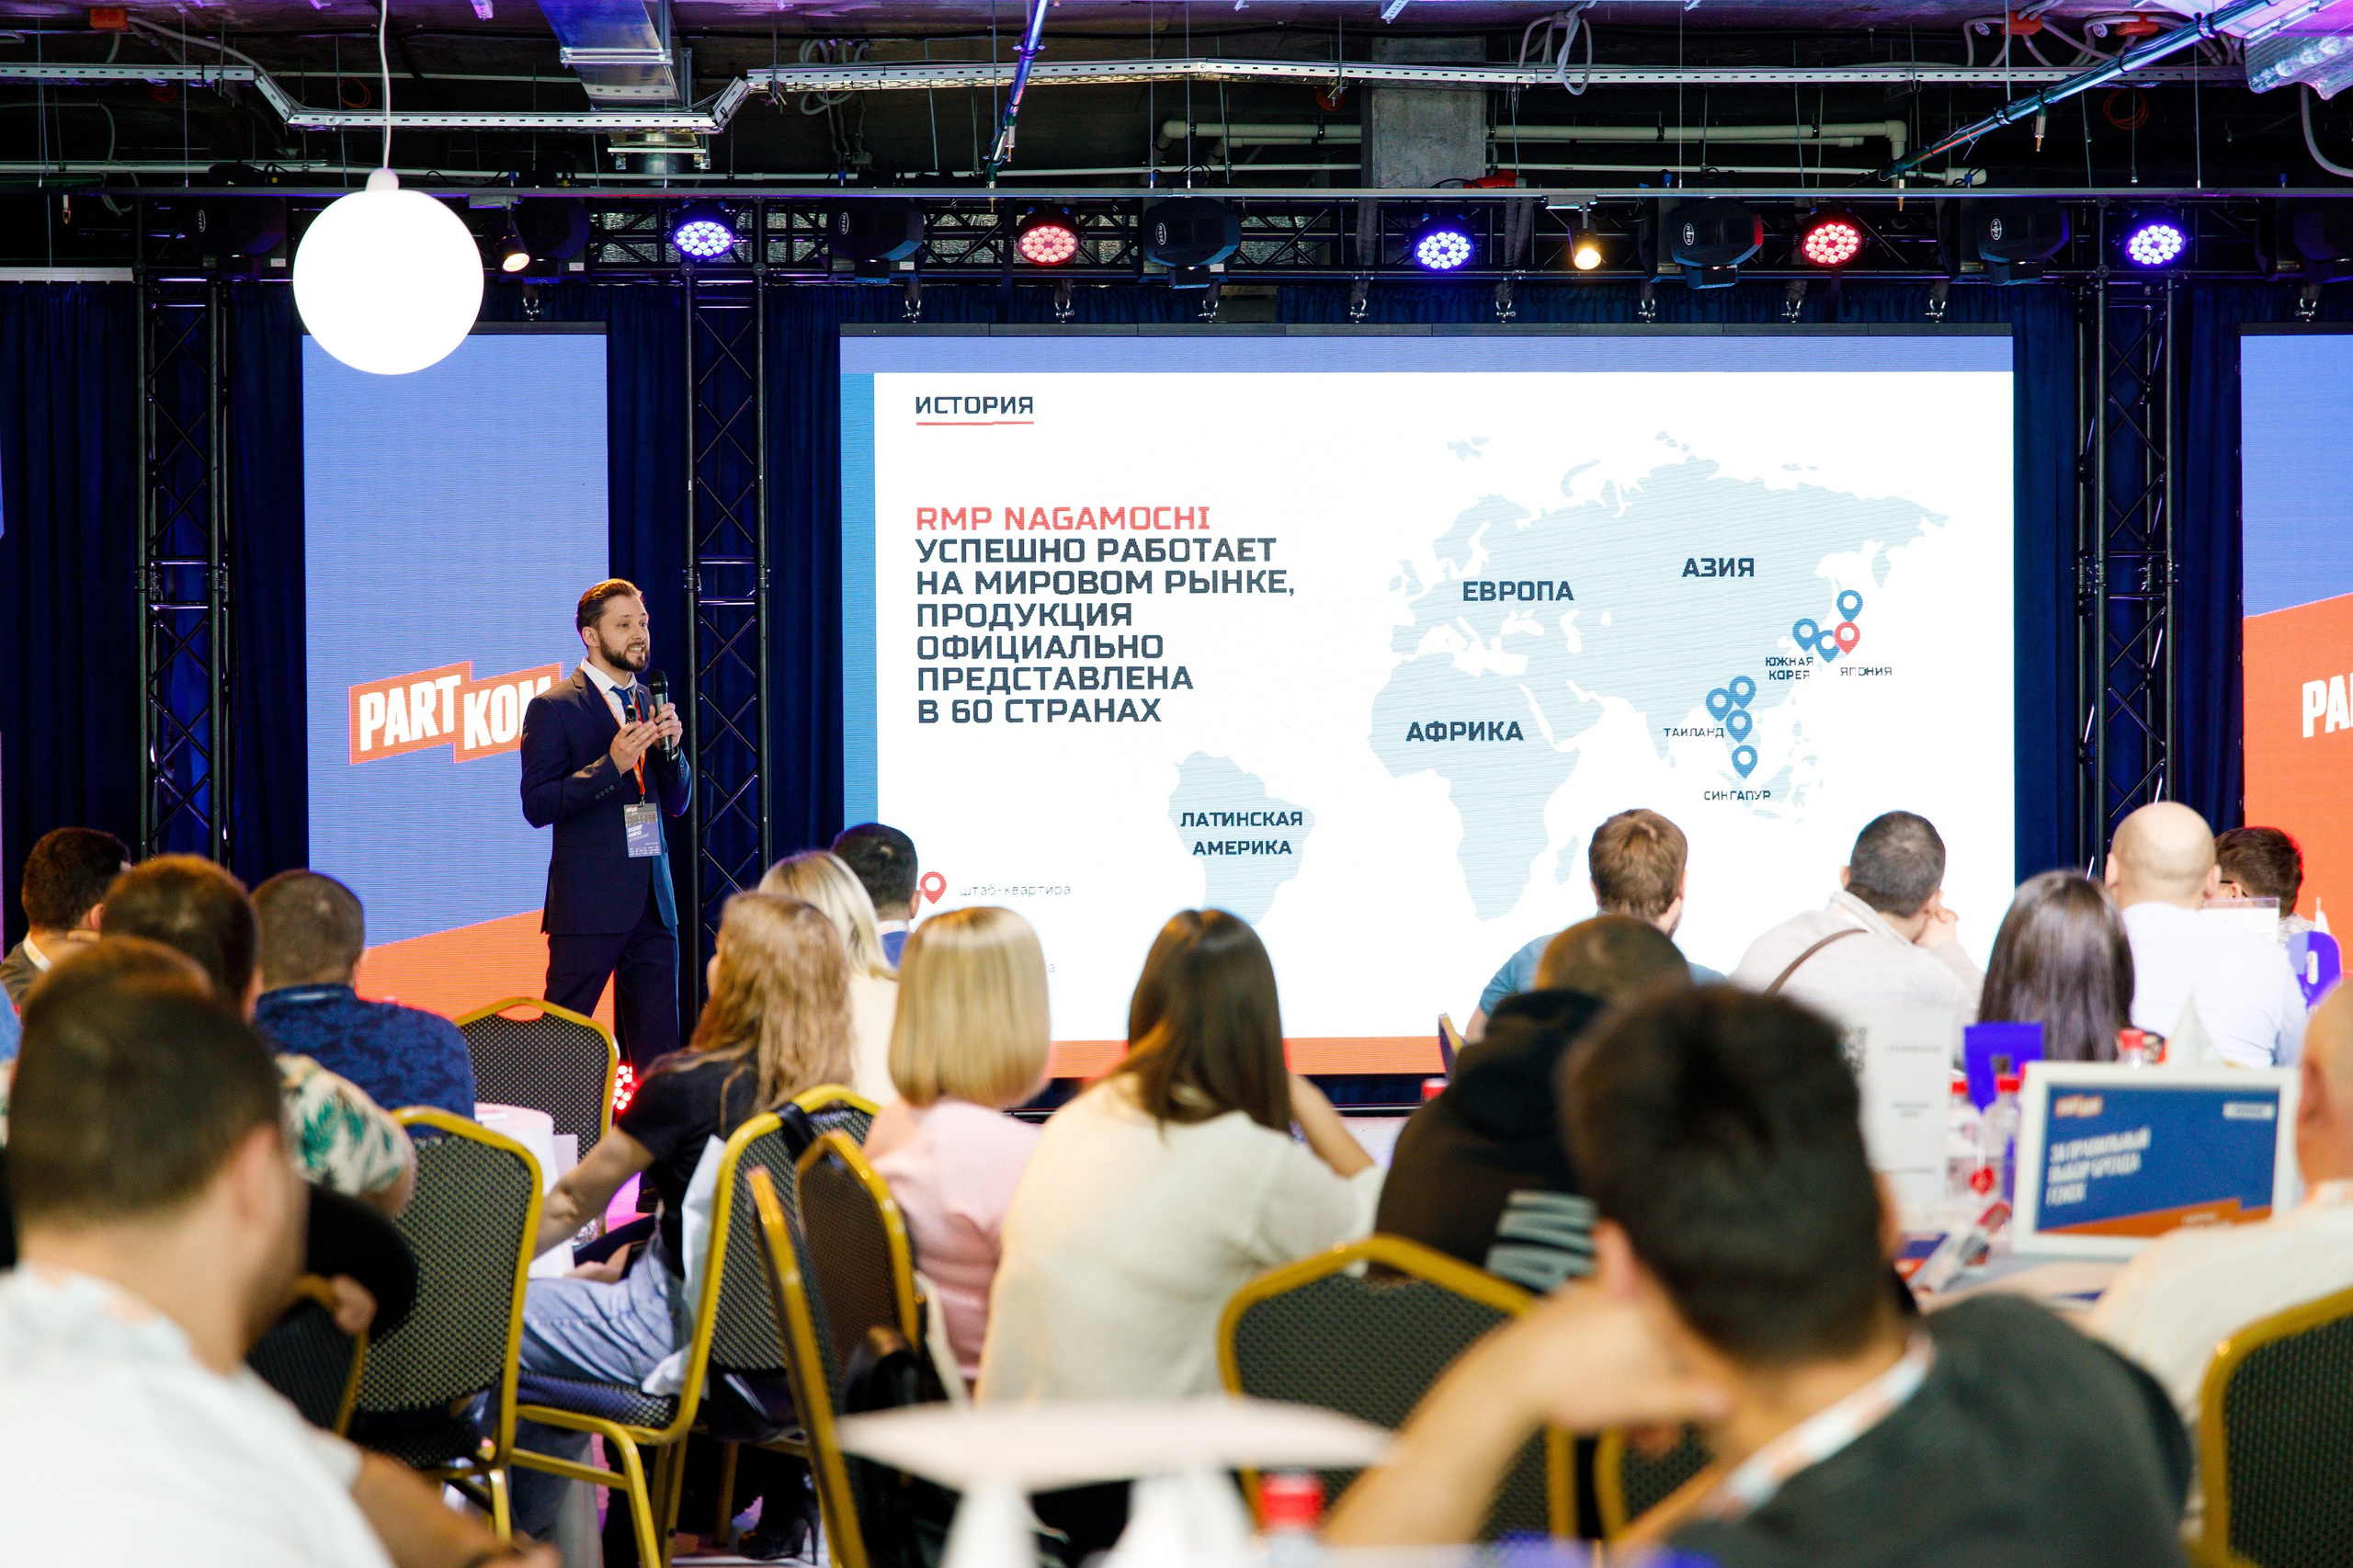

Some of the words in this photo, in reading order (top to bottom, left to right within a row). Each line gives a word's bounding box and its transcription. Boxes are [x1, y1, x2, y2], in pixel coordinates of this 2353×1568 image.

[915, 396, 1034, 415] ИСТОРИЯ
[916, 506, 993, 531] RMP
[1005, 506, 1211, 531] NAGAMOCHI
[915, 538, 1086, 563] УСПЕШНО
[1097, 537, 1277, 562] РАБОТАЕТ
[1681, 557, 1756, 578] АЗИЯ
[916, 571, 964, 596] НА
[975, 570, 1153, 596] МИРОВОМ
[1165, 569, 1295, 597] РЫНКЕ,
[1461, 580, 1575, 602] ЕВРОПА
[917, 602, 1132, 632] ПРОДУКЦИЯ
[916, 634, 1164, 664] ОФИЦИАЛЬНО
[1765, 656, 1814, 667] ЮЖНАЯ
[917, 665, 1194, 696] ПРЕДСТАВЛЕНА
[1768, 669, 1811, 681] КОРЕЯ
[359, 674, 461, 752] PART
[918, 699, 939, 724] В
[951, 699, 993, 724] 60
[1005, 698, 1162, 723] СТРАНАХ
[2302, 671, 2353, 739] PA
[1405, 720, 1524, 743] АФРИКА
[1664, 727, 1724, 739] ТАИЛАНД
[1703, 790, 1771, 801] СИНГАПУР
[1180, 811, 1303, 828] ЛАТИНСКАЯ
[1192, 839, 1293, 856] АМЕРИКА
[960, 883, 1072, 898] штаб-квартира
